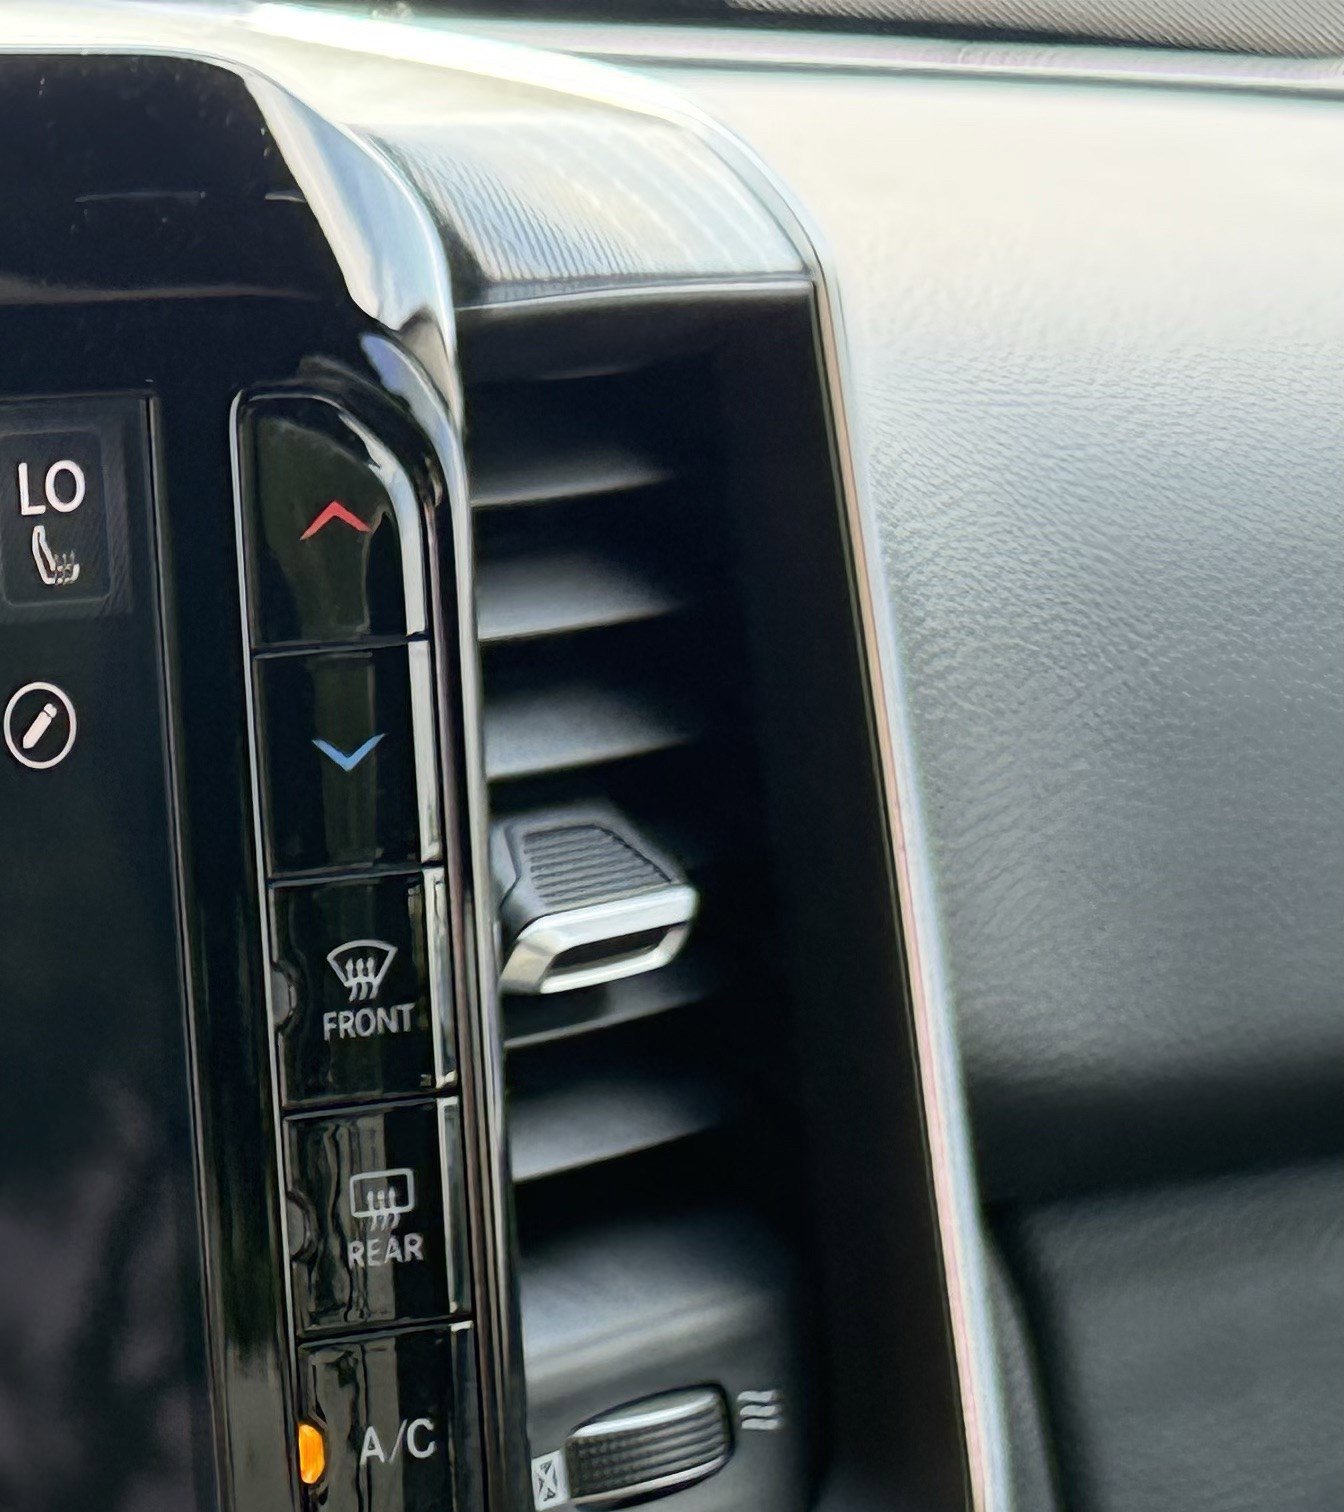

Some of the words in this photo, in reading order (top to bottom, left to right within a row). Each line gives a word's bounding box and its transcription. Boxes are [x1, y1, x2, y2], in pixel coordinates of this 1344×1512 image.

[18, 459, 87, 516] LO
[322, 1001, 417, 1042] FRONT
[346, 1232, 424, 1268] REAR
[358, 1417, 438, 1467] A/C
